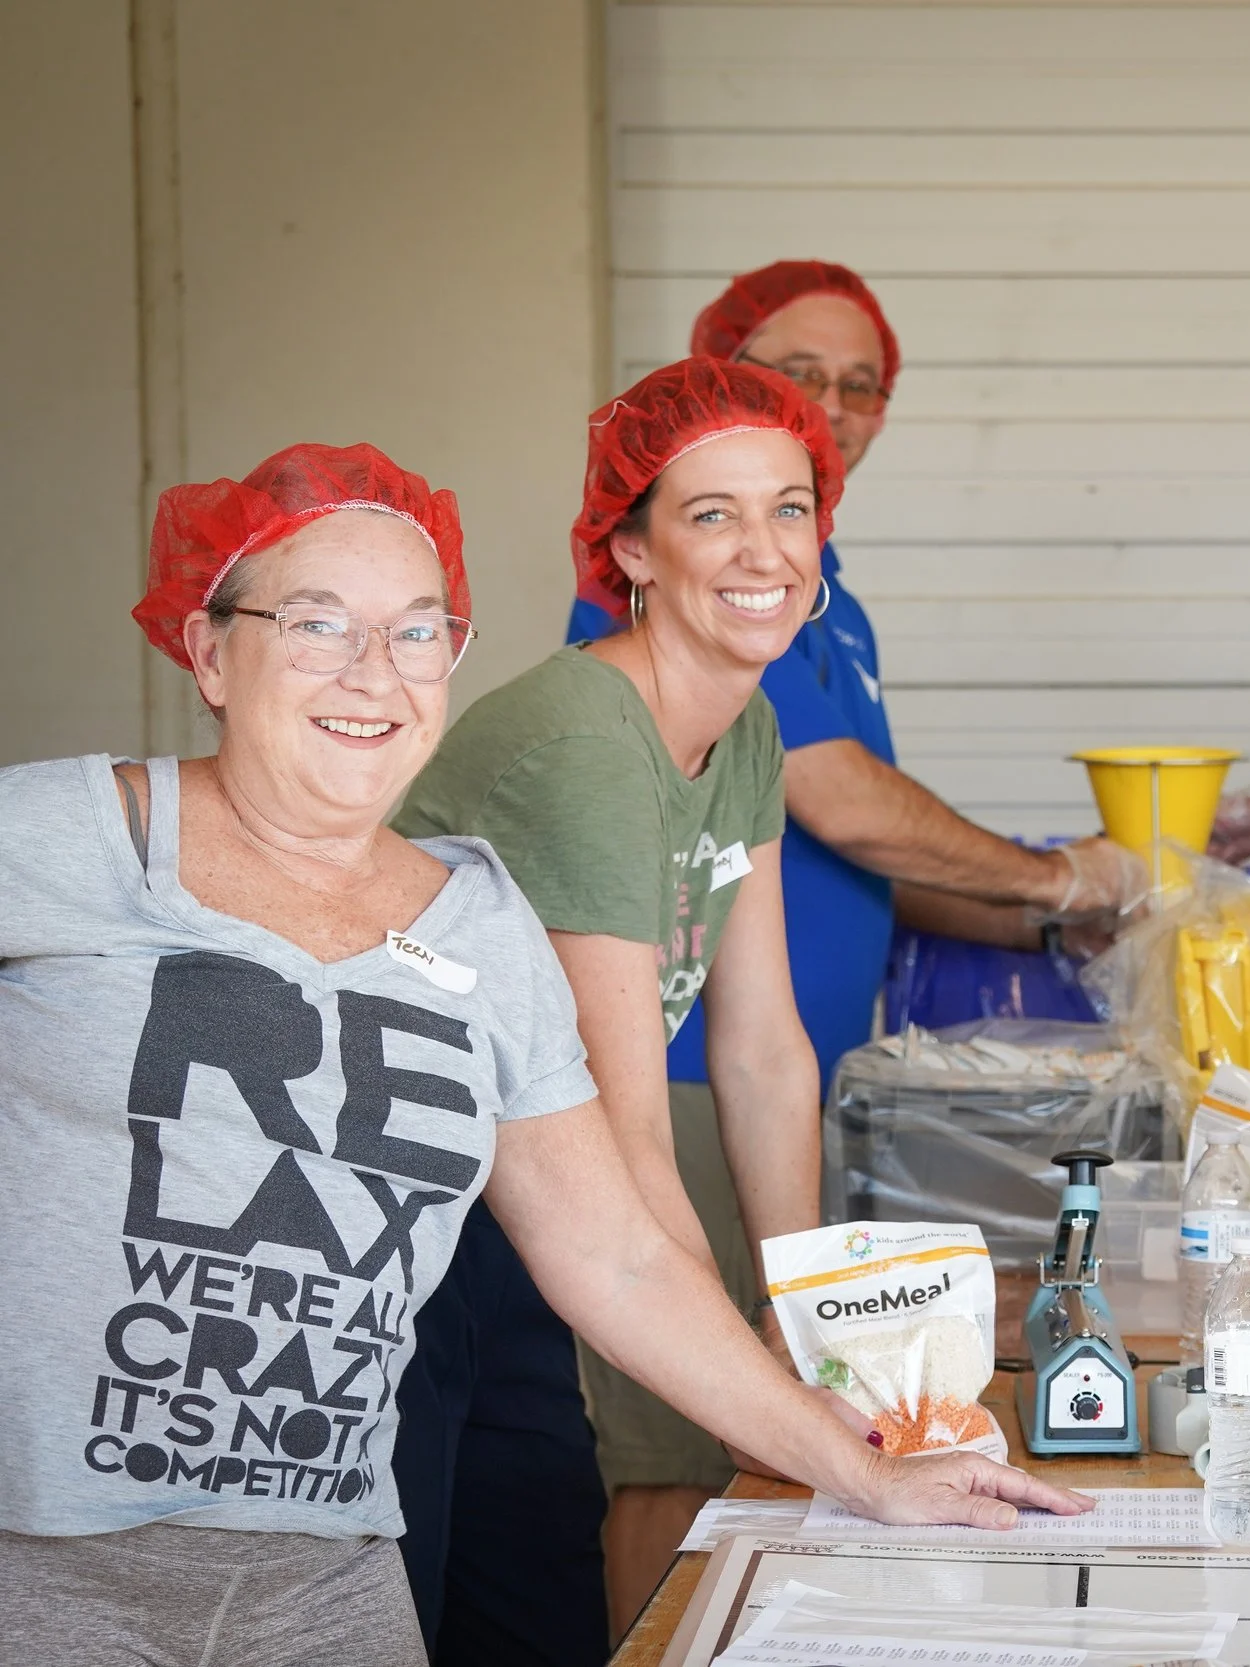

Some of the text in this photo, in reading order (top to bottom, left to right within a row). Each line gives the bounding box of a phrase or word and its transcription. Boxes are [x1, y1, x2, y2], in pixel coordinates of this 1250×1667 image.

[127, 950, 482, 1192] RE
[122, 1117, 460, 1294] LAX
[121, 1241, 406, 1345] WE'RE ALL
[816, 1272, 952, 1320] OneMeal
[91, 1375, 217, 1446] IT'S
[230, 1403, 363, 1465] NOT
[84, 1434, 375, 1504] COMPETITION
